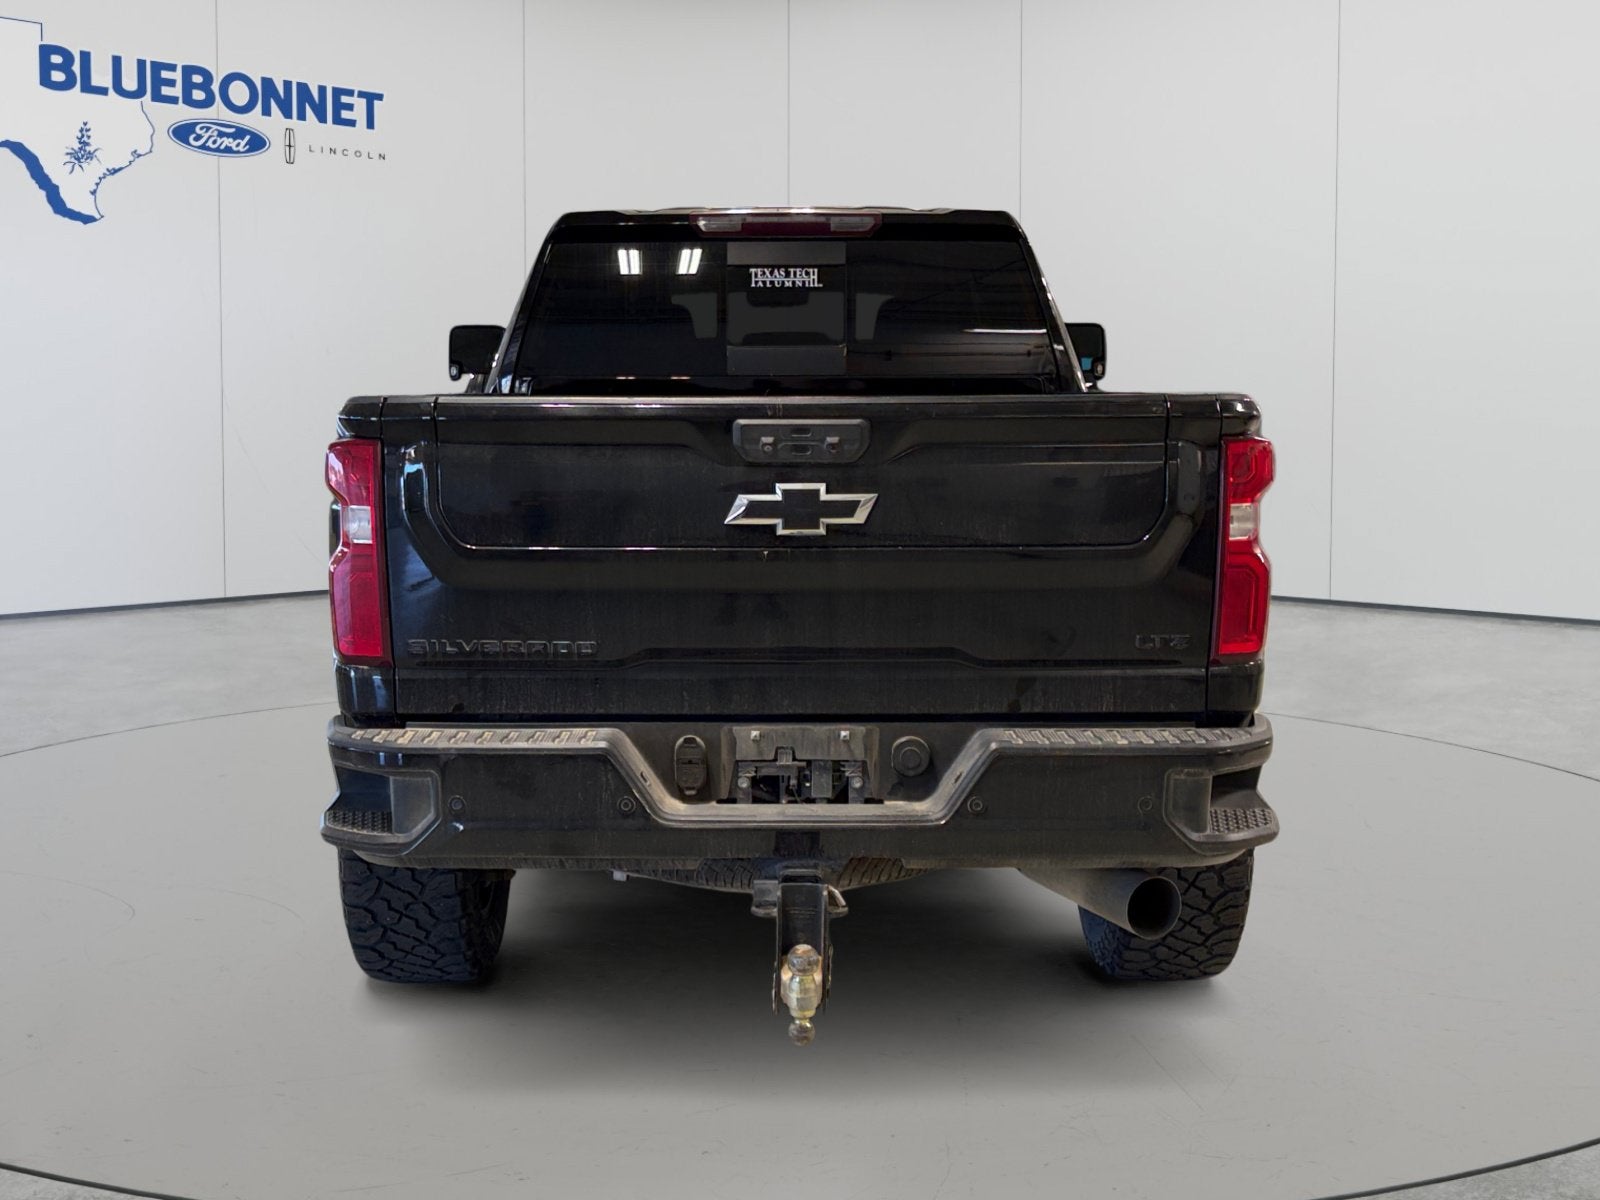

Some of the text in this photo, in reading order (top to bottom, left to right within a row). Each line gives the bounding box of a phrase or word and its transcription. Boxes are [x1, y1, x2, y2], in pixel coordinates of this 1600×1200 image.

[38, 43, 385, 130] BLUEBONNET
[189, 123, 250, 153] Ford
[308, 144, 387, 161] LINCOLN
[749, 268, 819, 283] TEXAS TECH
[756, 280, 811, 288] ALUMNI
[407, 639, 598, 656] SILVERADO
